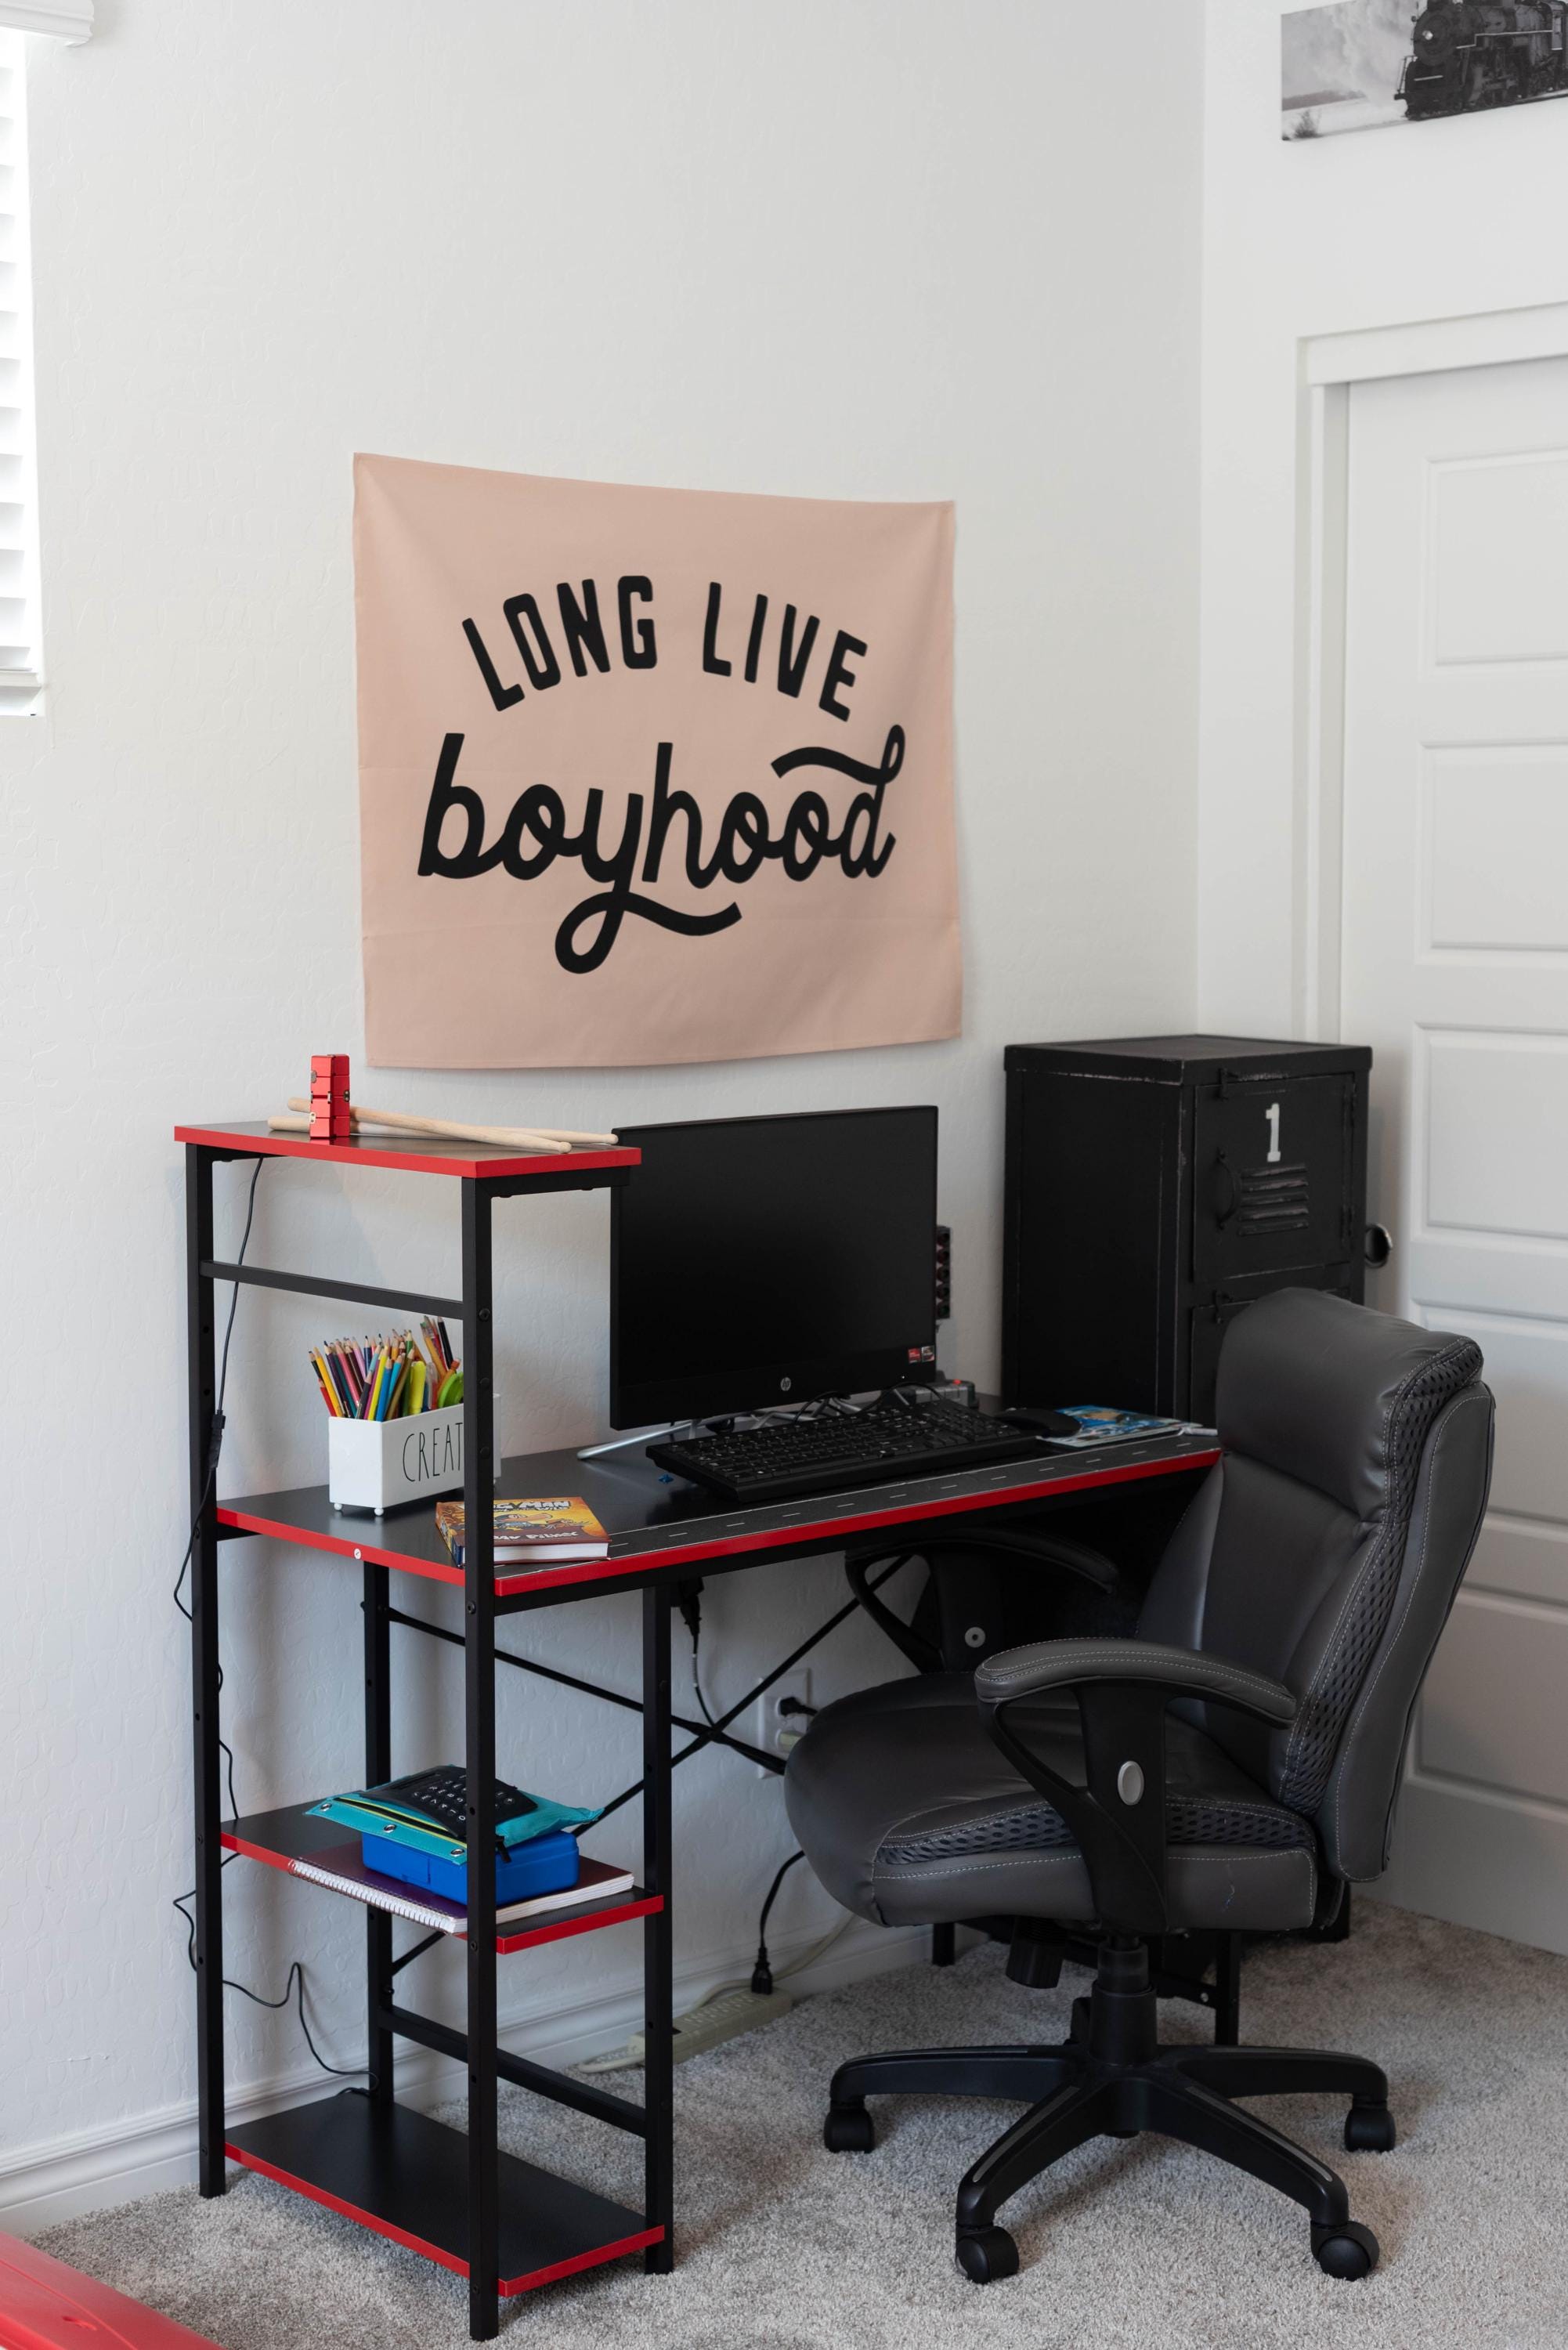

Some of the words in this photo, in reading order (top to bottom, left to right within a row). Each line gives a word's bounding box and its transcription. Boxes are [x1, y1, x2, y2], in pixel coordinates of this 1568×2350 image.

[462, 576, 656, 711] LONG
[703, 582, 867, 721] LIVE
[417, 725, 905, 974] boyhood
[1265, 1103, 1281, 1162] 1
[781, 1377, 791, 1392] hp
